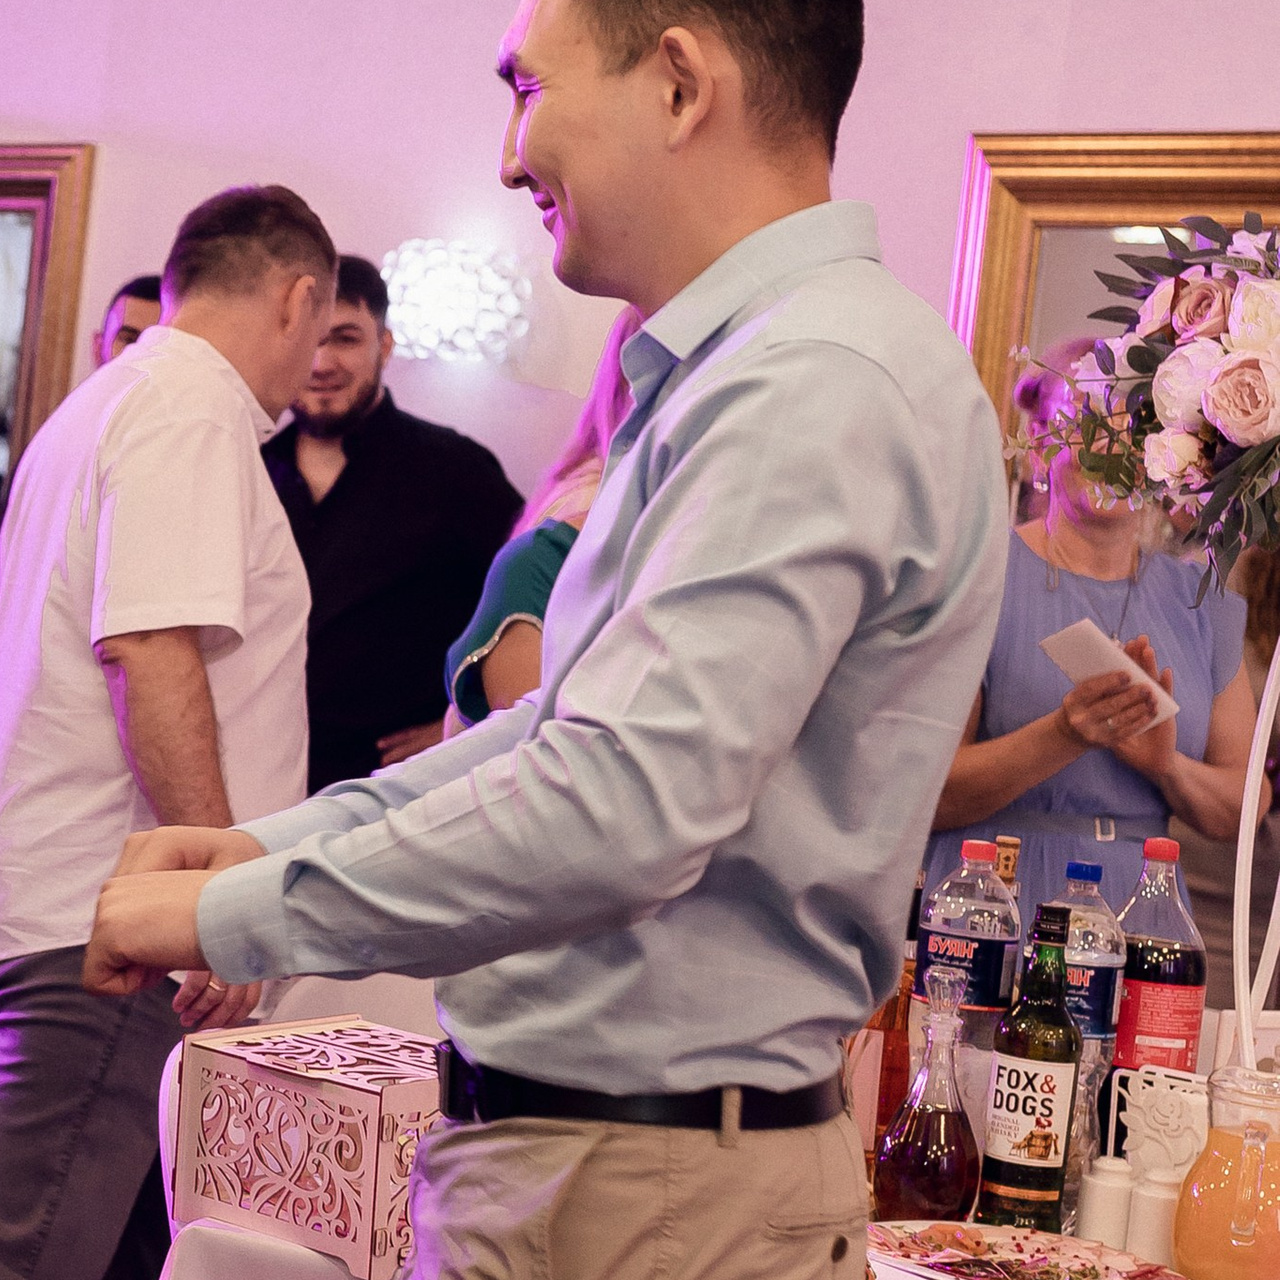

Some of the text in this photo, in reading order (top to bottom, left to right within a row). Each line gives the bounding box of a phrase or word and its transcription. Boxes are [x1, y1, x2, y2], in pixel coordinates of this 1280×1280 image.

[927, 934, 974, 959] БУЯН
[1066, 967, 1091, 987] ЯН
[993, 1087, 1054, 1118] DOGS
